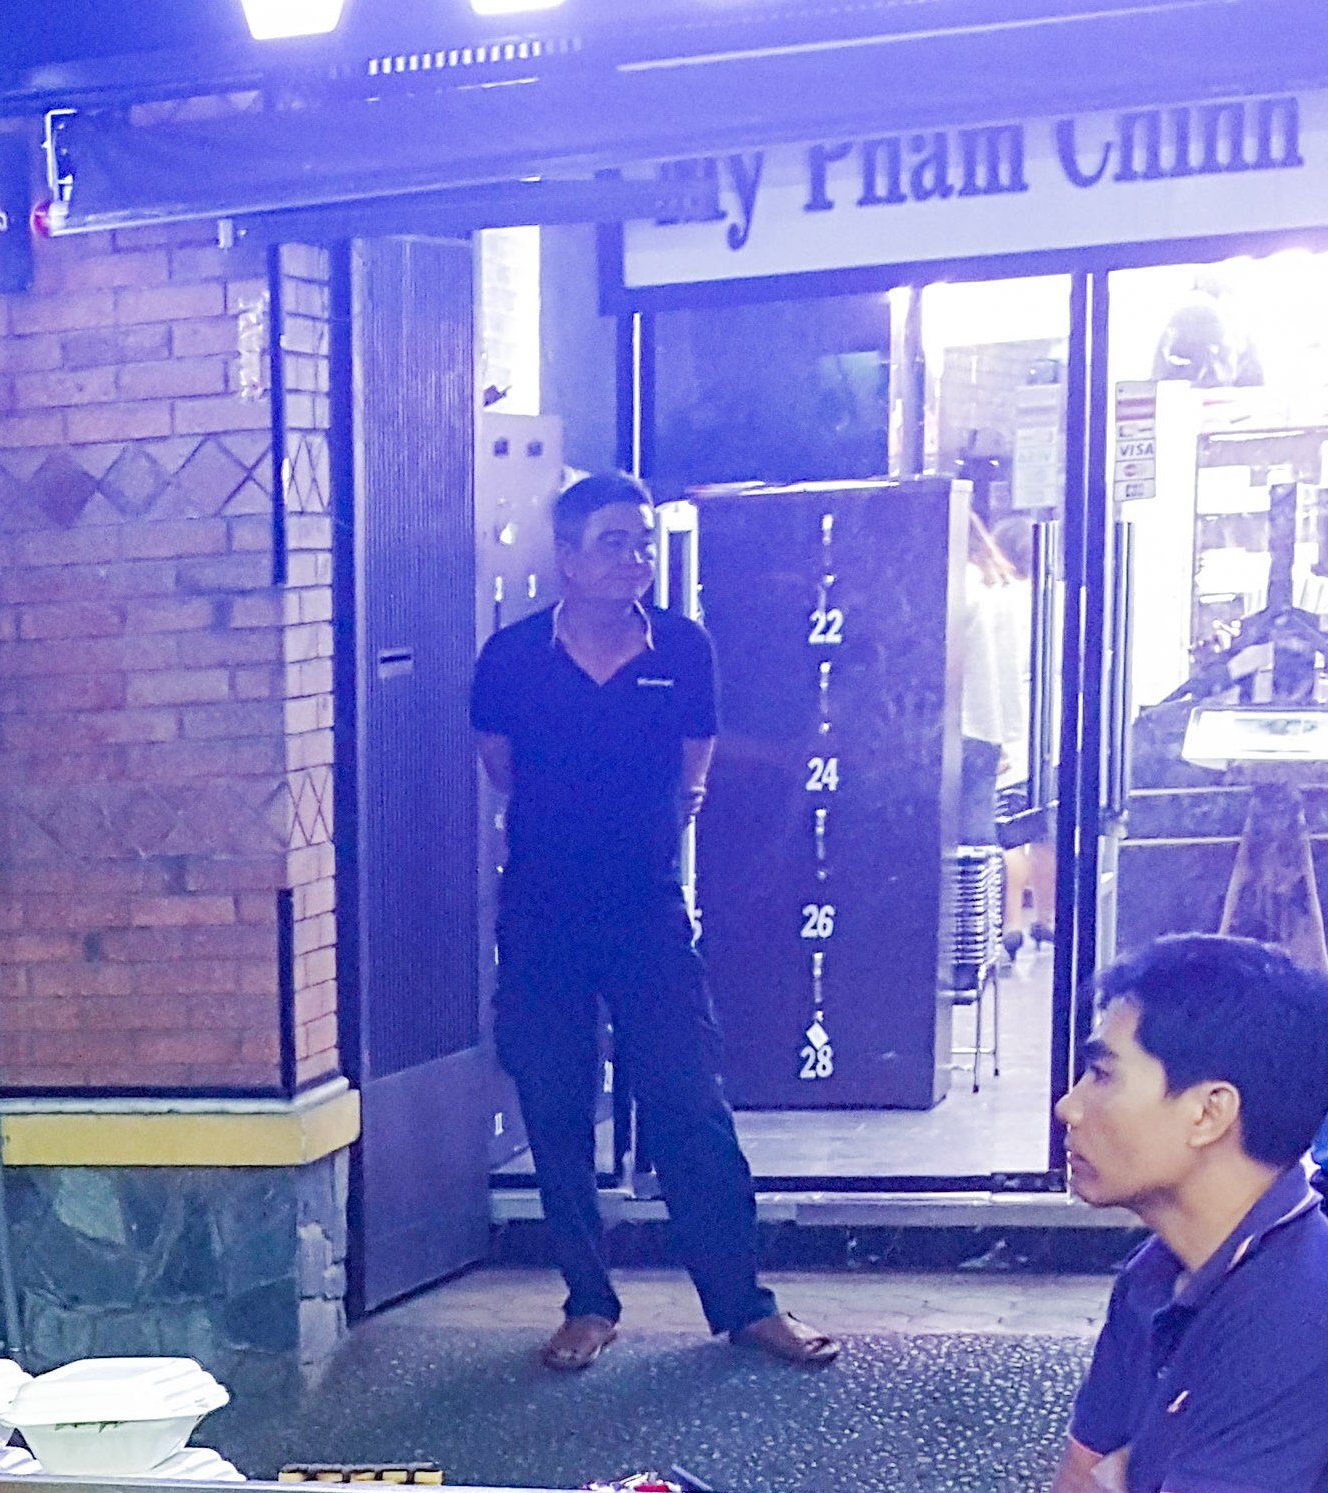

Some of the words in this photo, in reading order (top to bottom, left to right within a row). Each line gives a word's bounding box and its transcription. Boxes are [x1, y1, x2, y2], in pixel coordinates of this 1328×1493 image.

[1119, 442, 1154, 456] VISA
[808, 608, 844, 644] 22
[805, 756, 840, 792] 24
[800, 903, 836, 939] 26
[799, 1044, 835, 1080] 28
